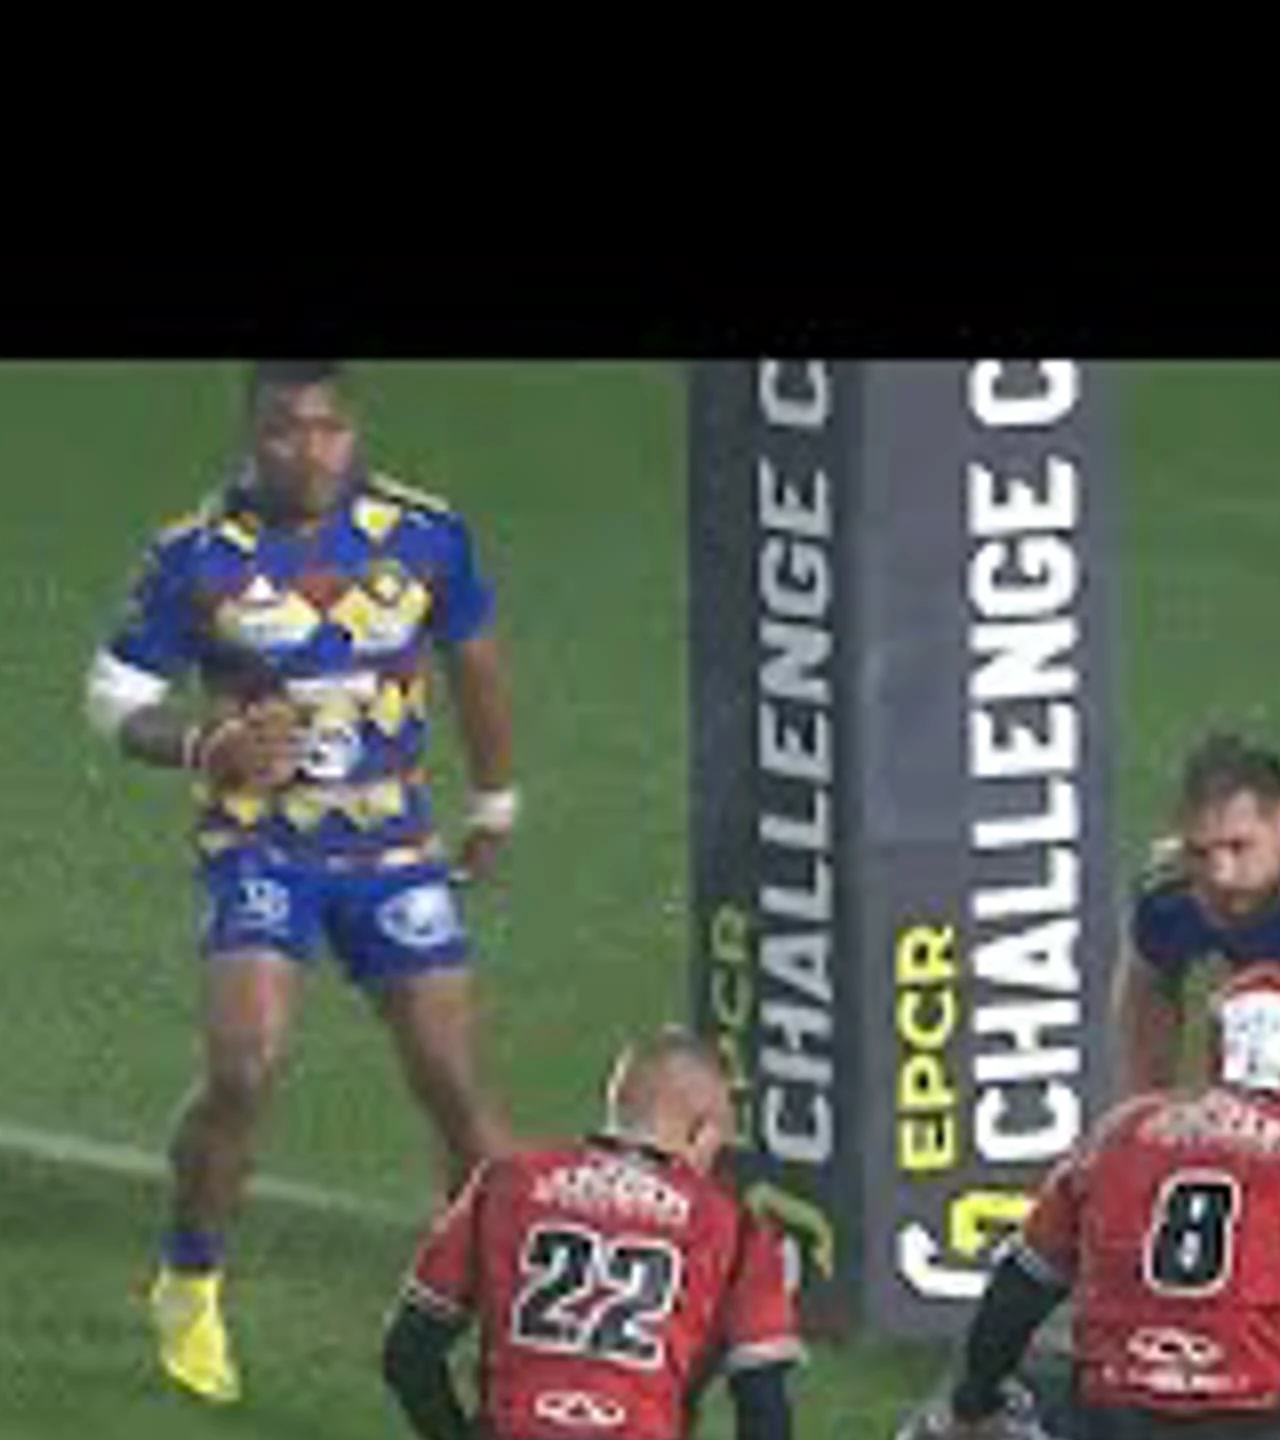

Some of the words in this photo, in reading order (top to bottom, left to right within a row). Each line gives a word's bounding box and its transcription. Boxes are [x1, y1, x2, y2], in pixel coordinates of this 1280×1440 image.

[758, 455, 834, 1164] CHALLENGE
[967, 453, 1081, 1163] CHALLENGE
[896, 923, 960, 1171] EPCR
[511, 1220, 683, 1371] 22
[1141, 1166, 1242, 1297] 8
